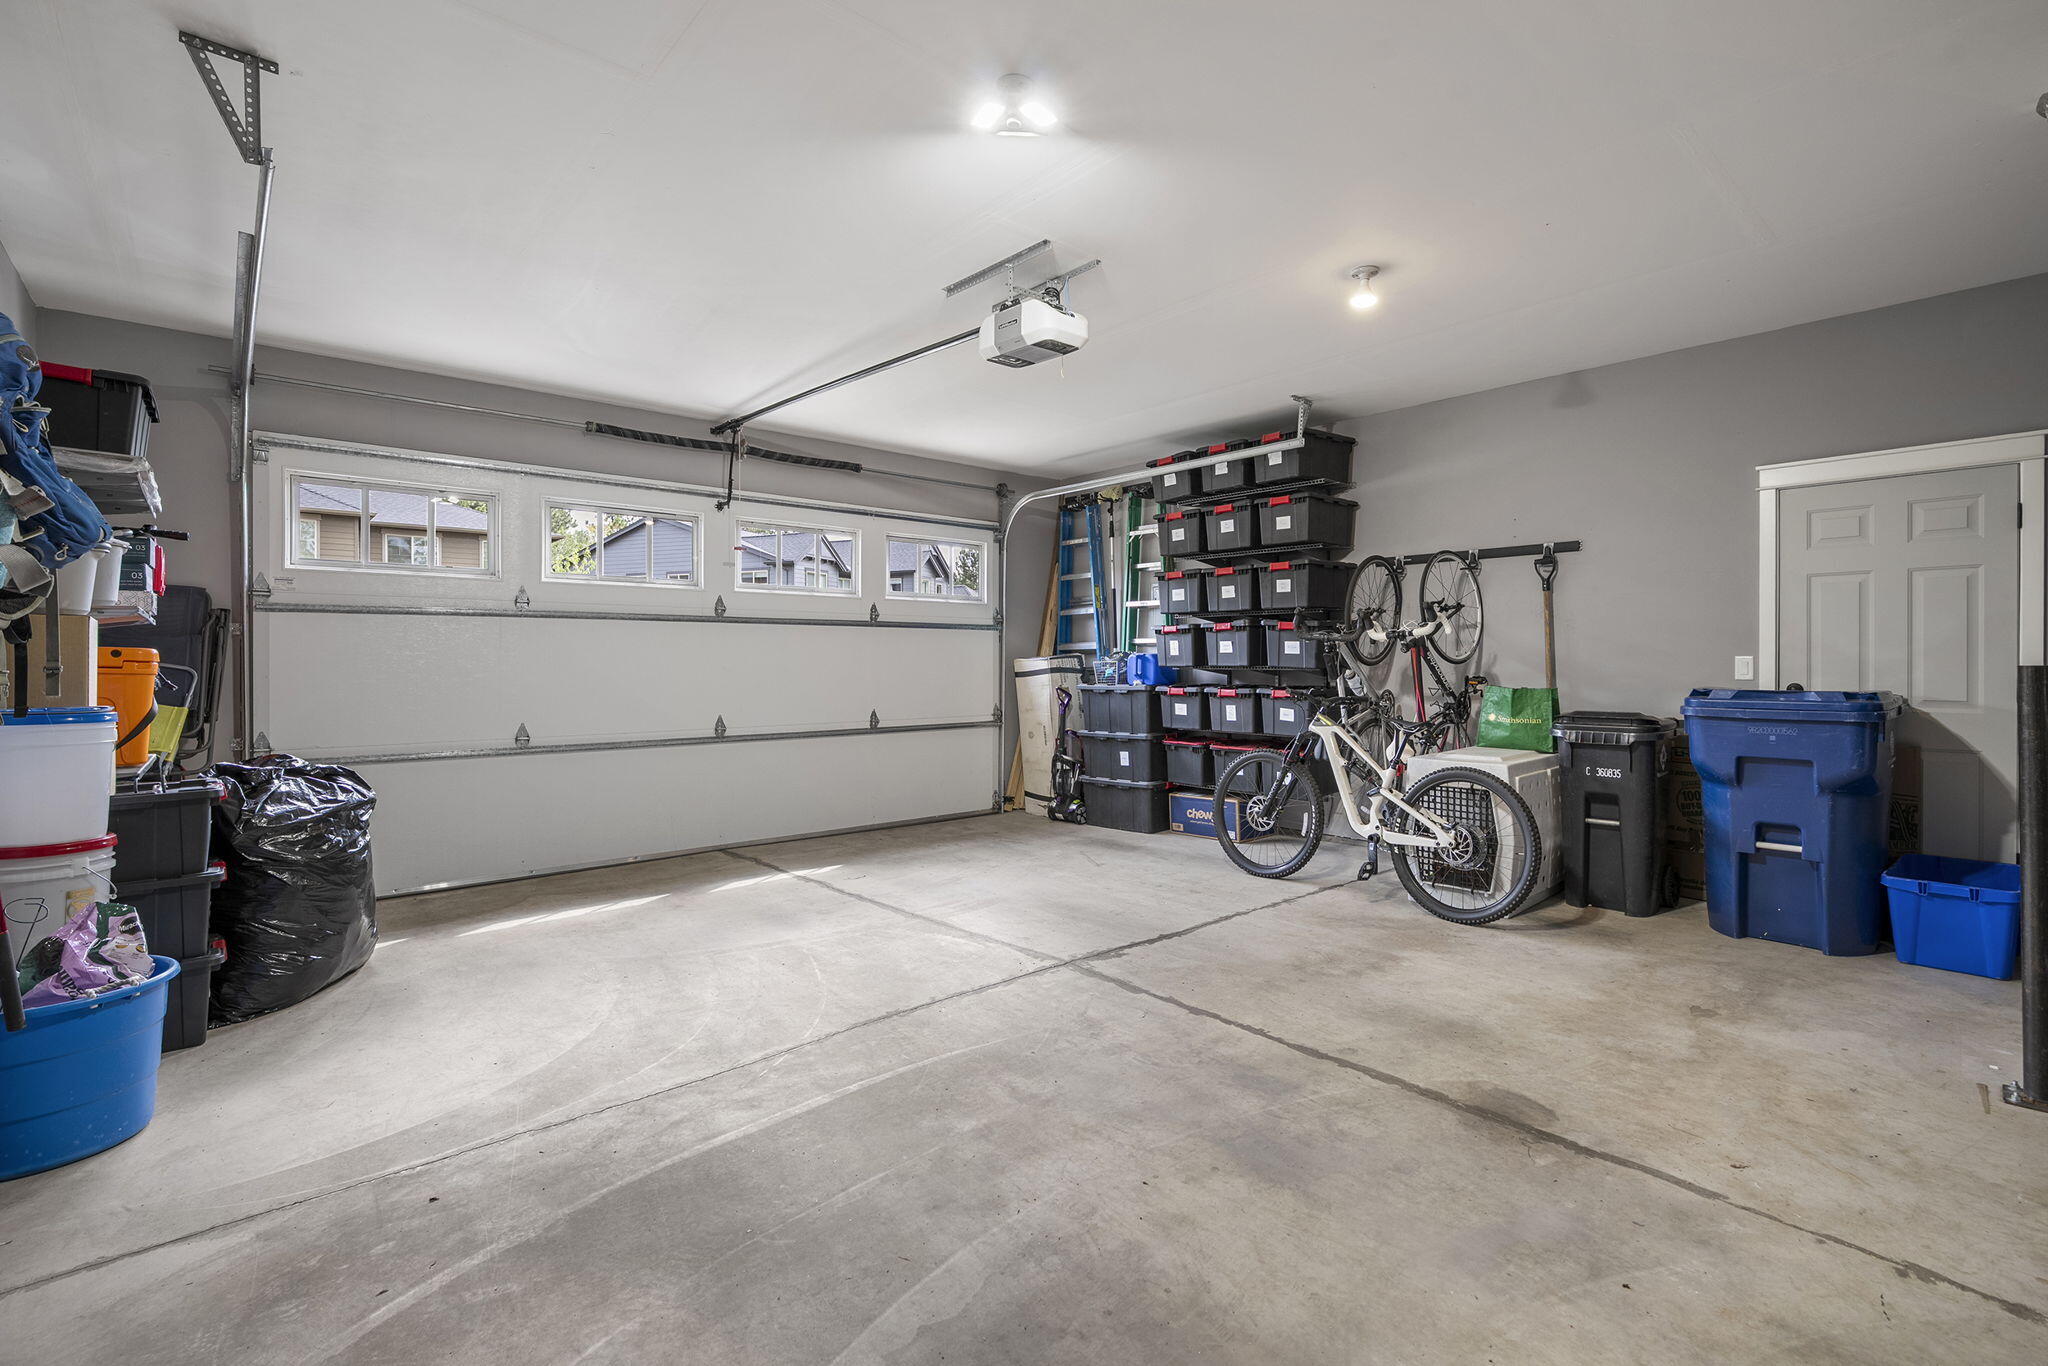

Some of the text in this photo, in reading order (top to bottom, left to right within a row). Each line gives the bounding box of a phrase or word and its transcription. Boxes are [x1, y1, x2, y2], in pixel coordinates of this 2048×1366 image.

[131, 571, 143, 579] 03
[1497, 714, 1542, 724] Smithsonian
[1585, 766, 1591, 776] C
